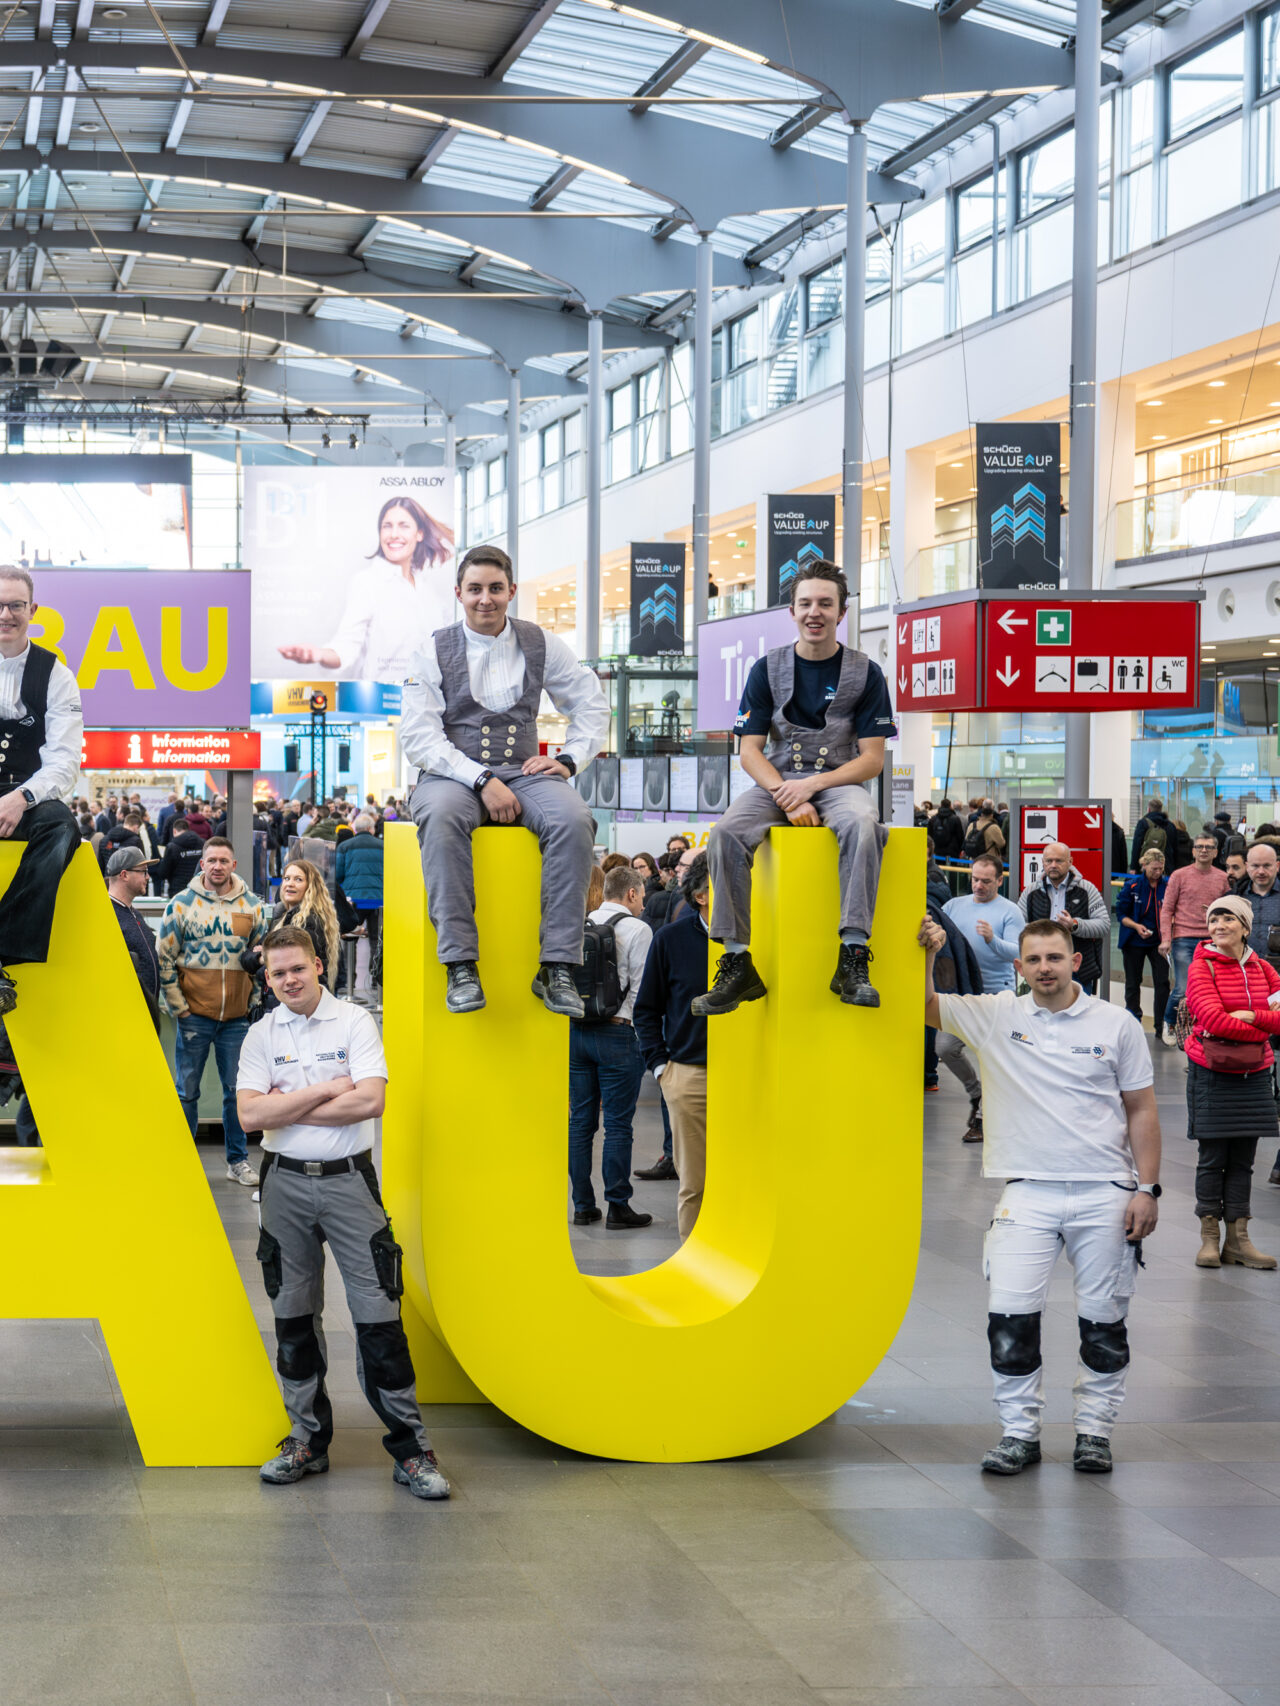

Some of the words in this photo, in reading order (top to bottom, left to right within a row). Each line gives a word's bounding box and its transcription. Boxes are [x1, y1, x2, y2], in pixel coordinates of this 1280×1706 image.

[983, 445, 1021, 453] SCHÜCO
[983, 455, 1024, 467] VALUE
[1036, 455, 1053, 467] UP
[379, 477, 407, 487] ASSA
[410, 477, 445, 487] ABLOY
[773, 520, 807, 530] VALUE
[815, 520, 830, 530] UP
[635, 564, 662, 573] VALUE
[1018, 582, 1056, 590] SCHÜCO
[152, 734, 230, 748] Information
[152, 749, 231, 763] Information
[681, 831, 710, 848] BA
